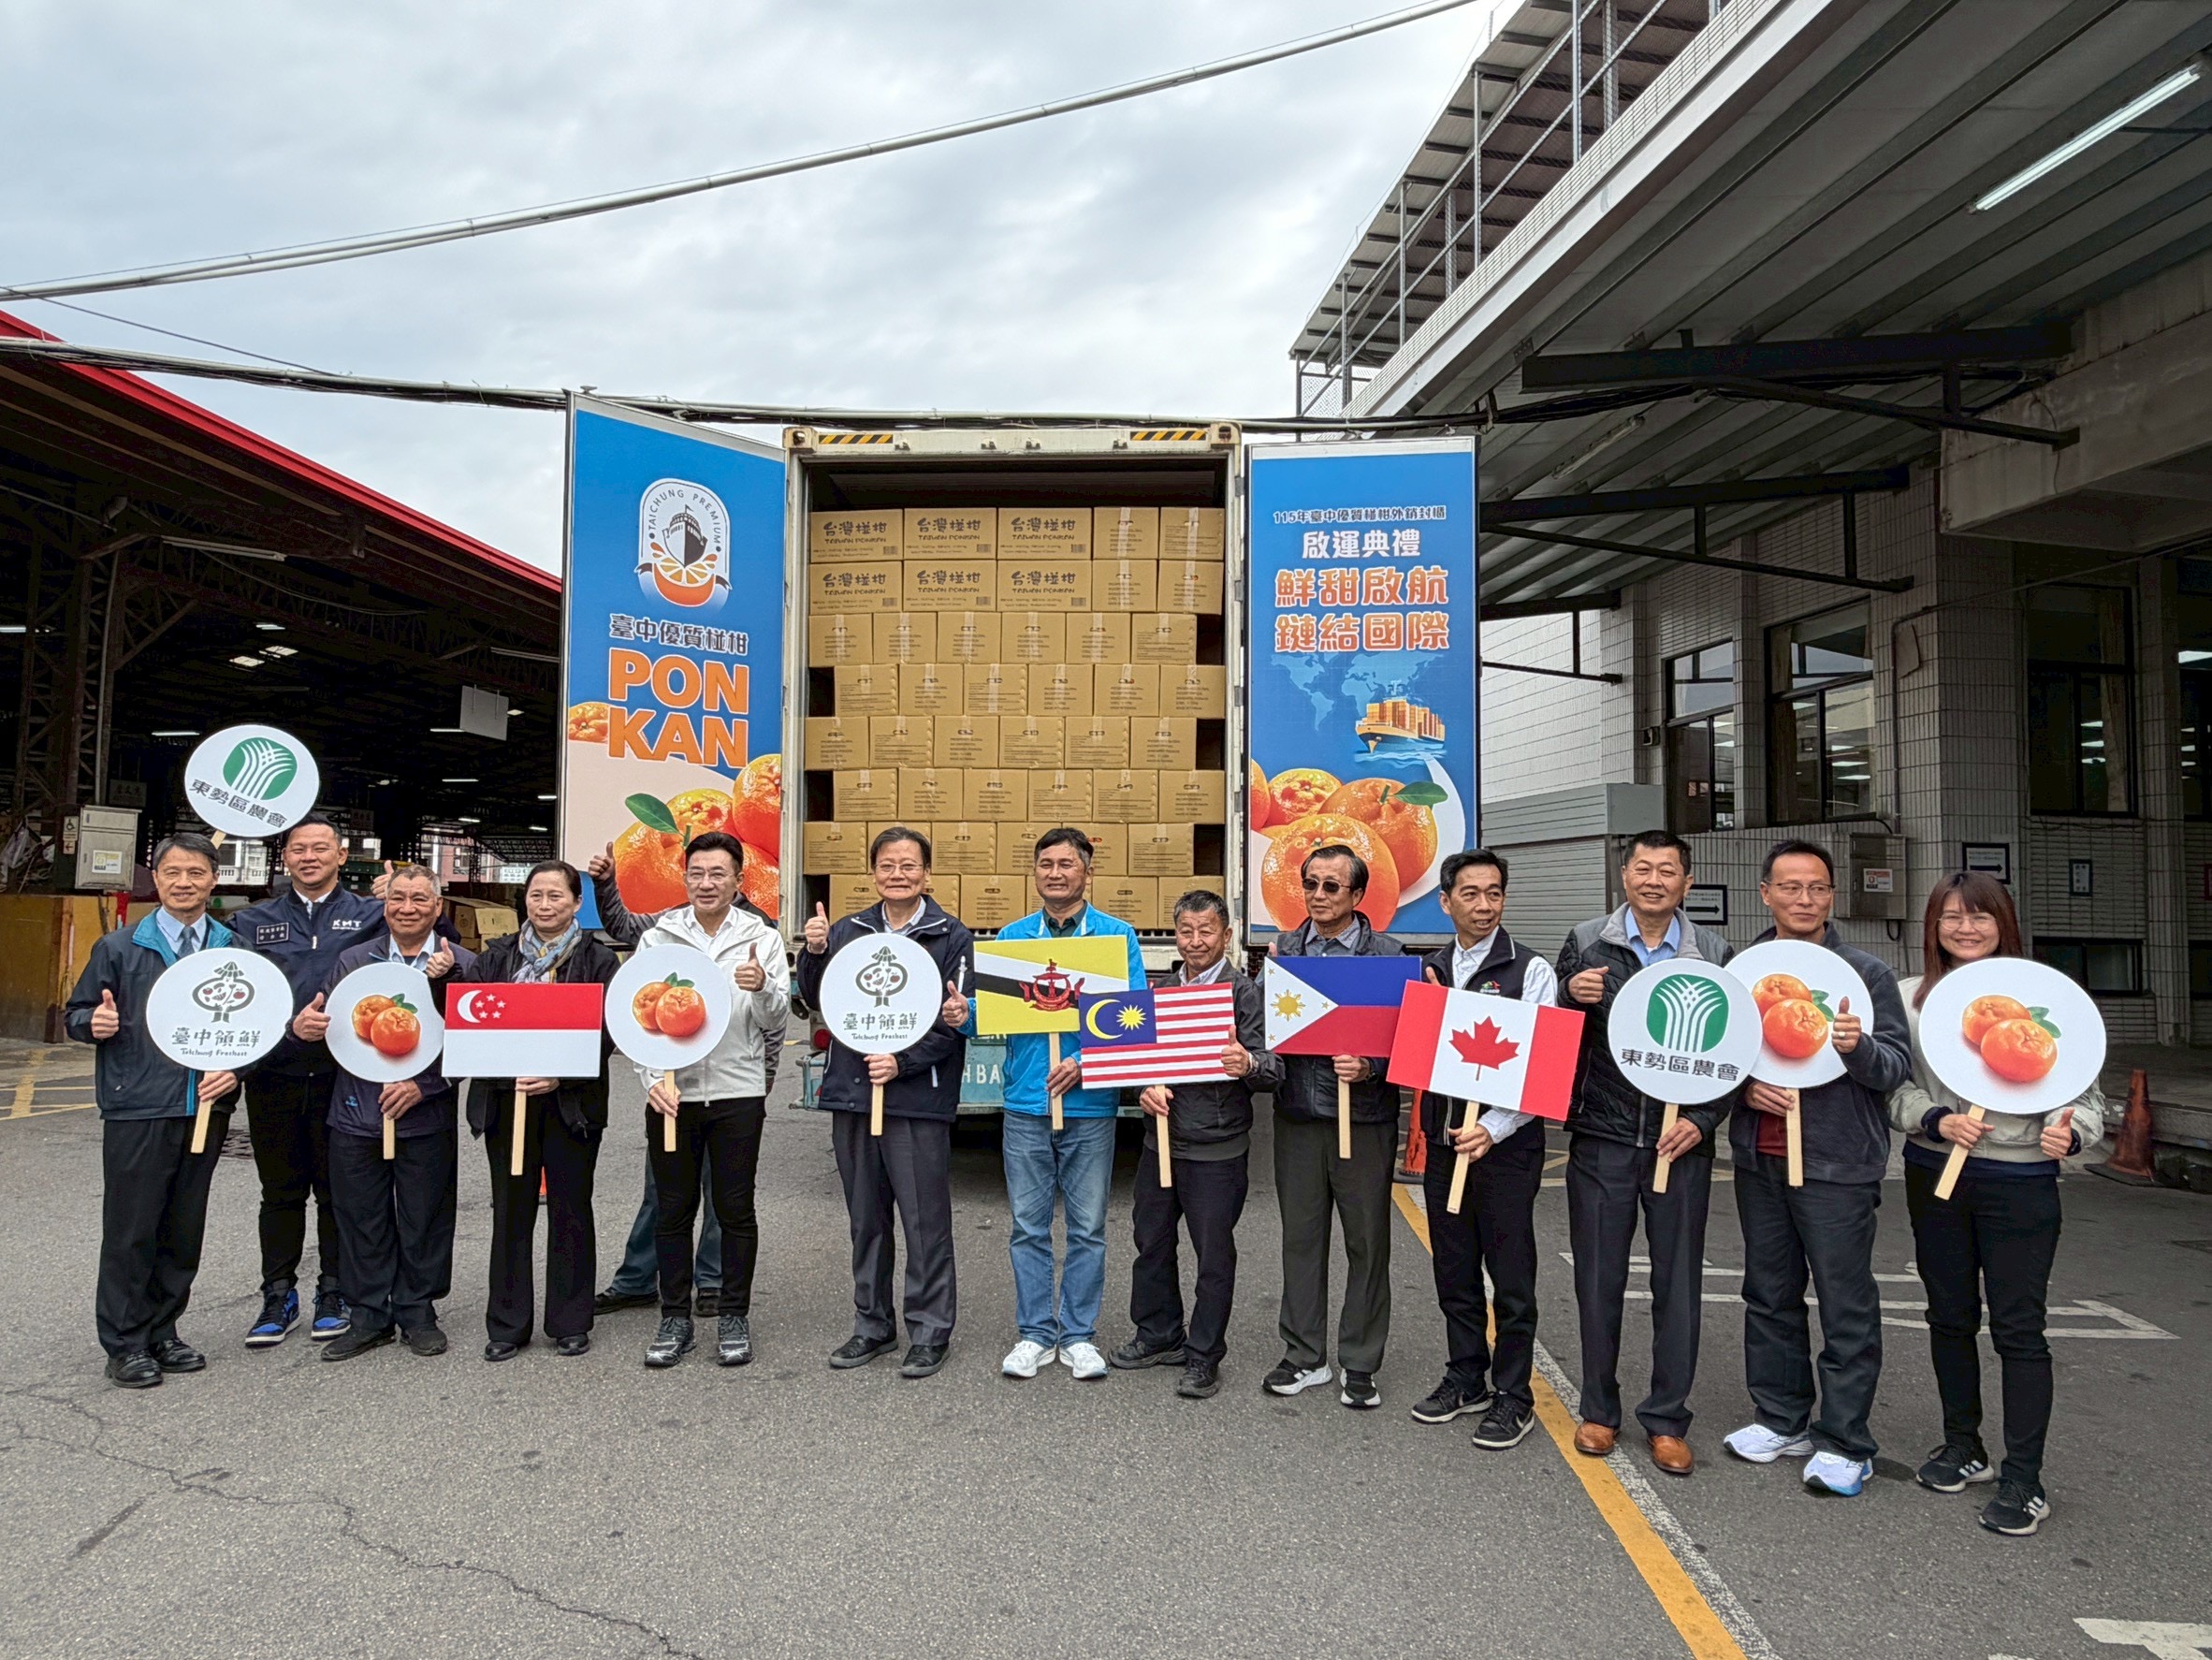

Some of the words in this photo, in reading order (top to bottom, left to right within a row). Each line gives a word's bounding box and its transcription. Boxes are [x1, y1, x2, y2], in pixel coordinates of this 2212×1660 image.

[648, 489, 685, 531] TAICHUNG
[692, 493, 721, 544] PREMIUM
[823, 521, 887, 536] 台灣椪柑
[917, 517, 981, 532] 台灣椪柑
[1011, 517, 1075, 532] 台灣椪柑
[1302, 529, 1420, 559] 啟運典禮
[822, 573, 886, 588] 台灣椪柑
[917, 570, 981, 585] 台灣椪柑
[1011, 571, 1075, 586] 台灣椪柑
[1275, 566, 1448, 607] 鮮甜啟航
[609, 614, 749, 655] 臺中優質椪柑
[1274, 611, 1449, 652] 鏈結國際
[609, 648, 749, 714] PON
[608, 706, 749, 769] KAN
[189, 779, 288, 828] 東勢區農會
[332, 919, 362, 927] KMT
[843, 1012, 918, 1030] 臺中領鮮
[171, 1027, 261, 1048] 臺中領鮮
[1621, 1048, 1740, 1081] 東勢區農會
